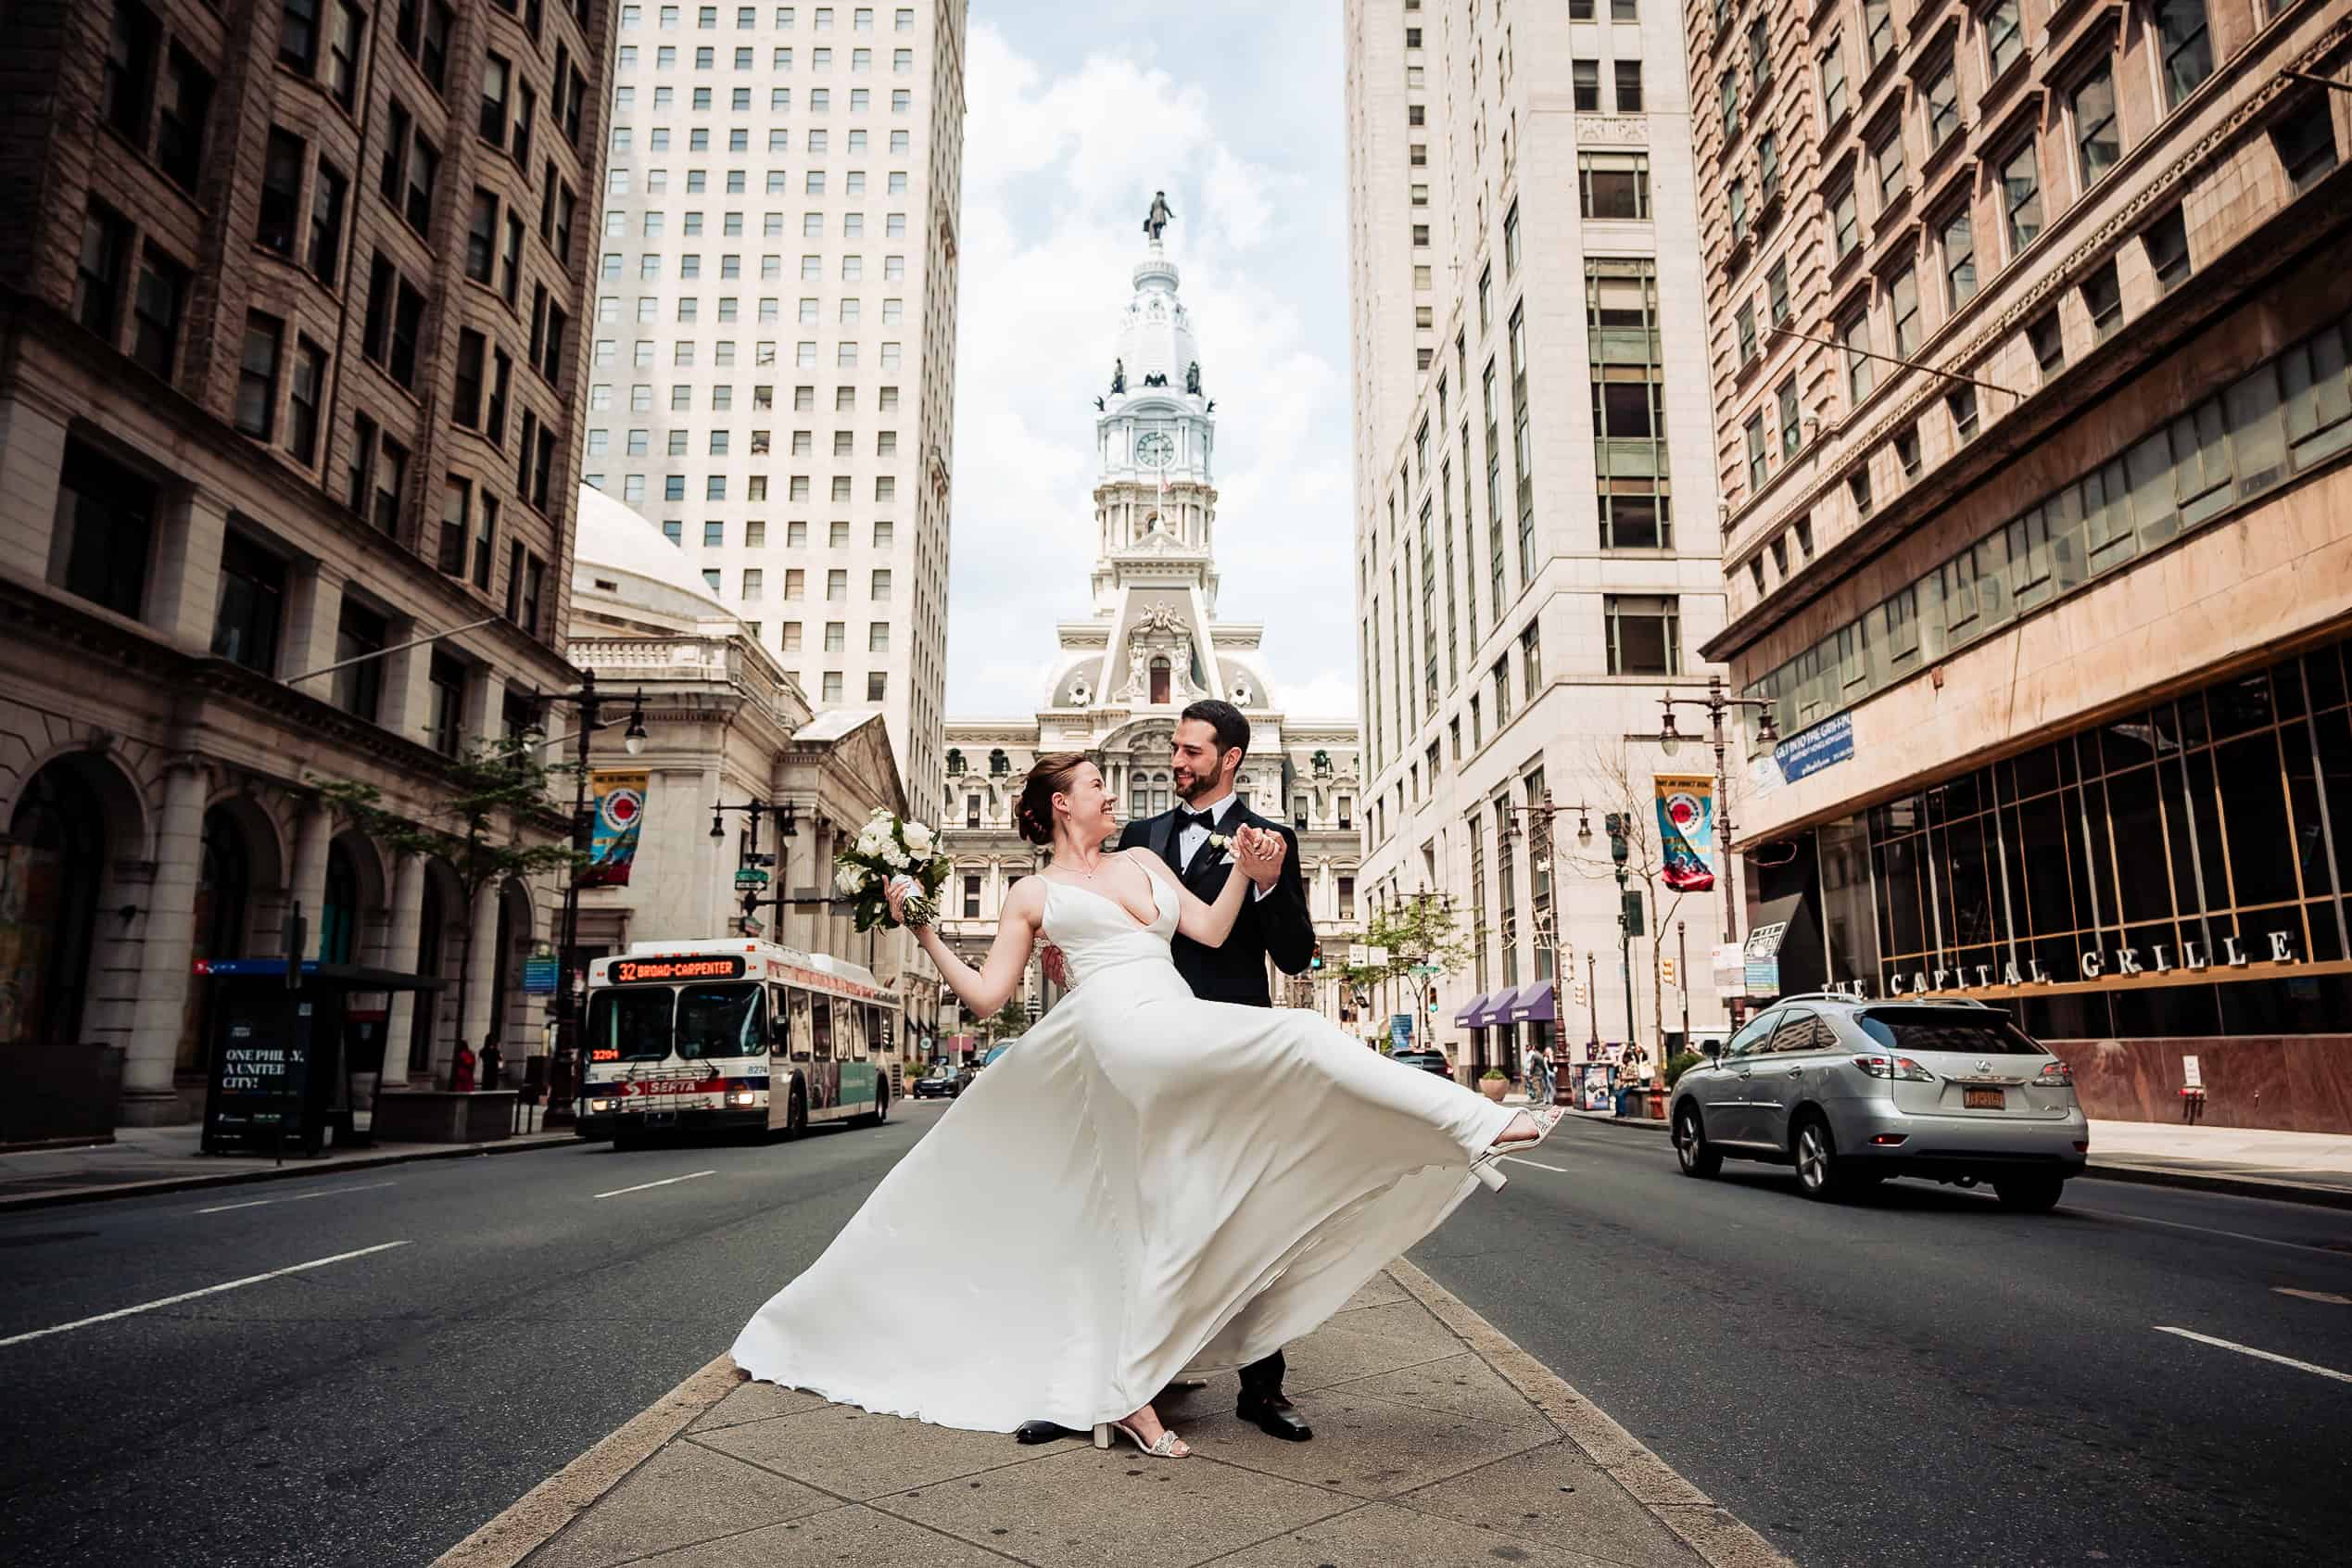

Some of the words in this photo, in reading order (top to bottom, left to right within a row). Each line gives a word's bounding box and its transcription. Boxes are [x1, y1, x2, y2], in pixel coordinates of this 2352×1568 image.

[619, 963, 637, 980] 32
[638, 961, 733, 978] BROAD-CARPENTER
[1822, 980, 1865, 1000] THE
[1891, 960, 2049, 995] CAPITAL
[2081, 930, 2293, 978] GRILLE
[225, 1049, 253, 1061] ONE
[223, 1063, 234, 1075] A
[221, 1077, 259, 1089] CITY!
[650, 1081, 696, 1094] SEPTA
